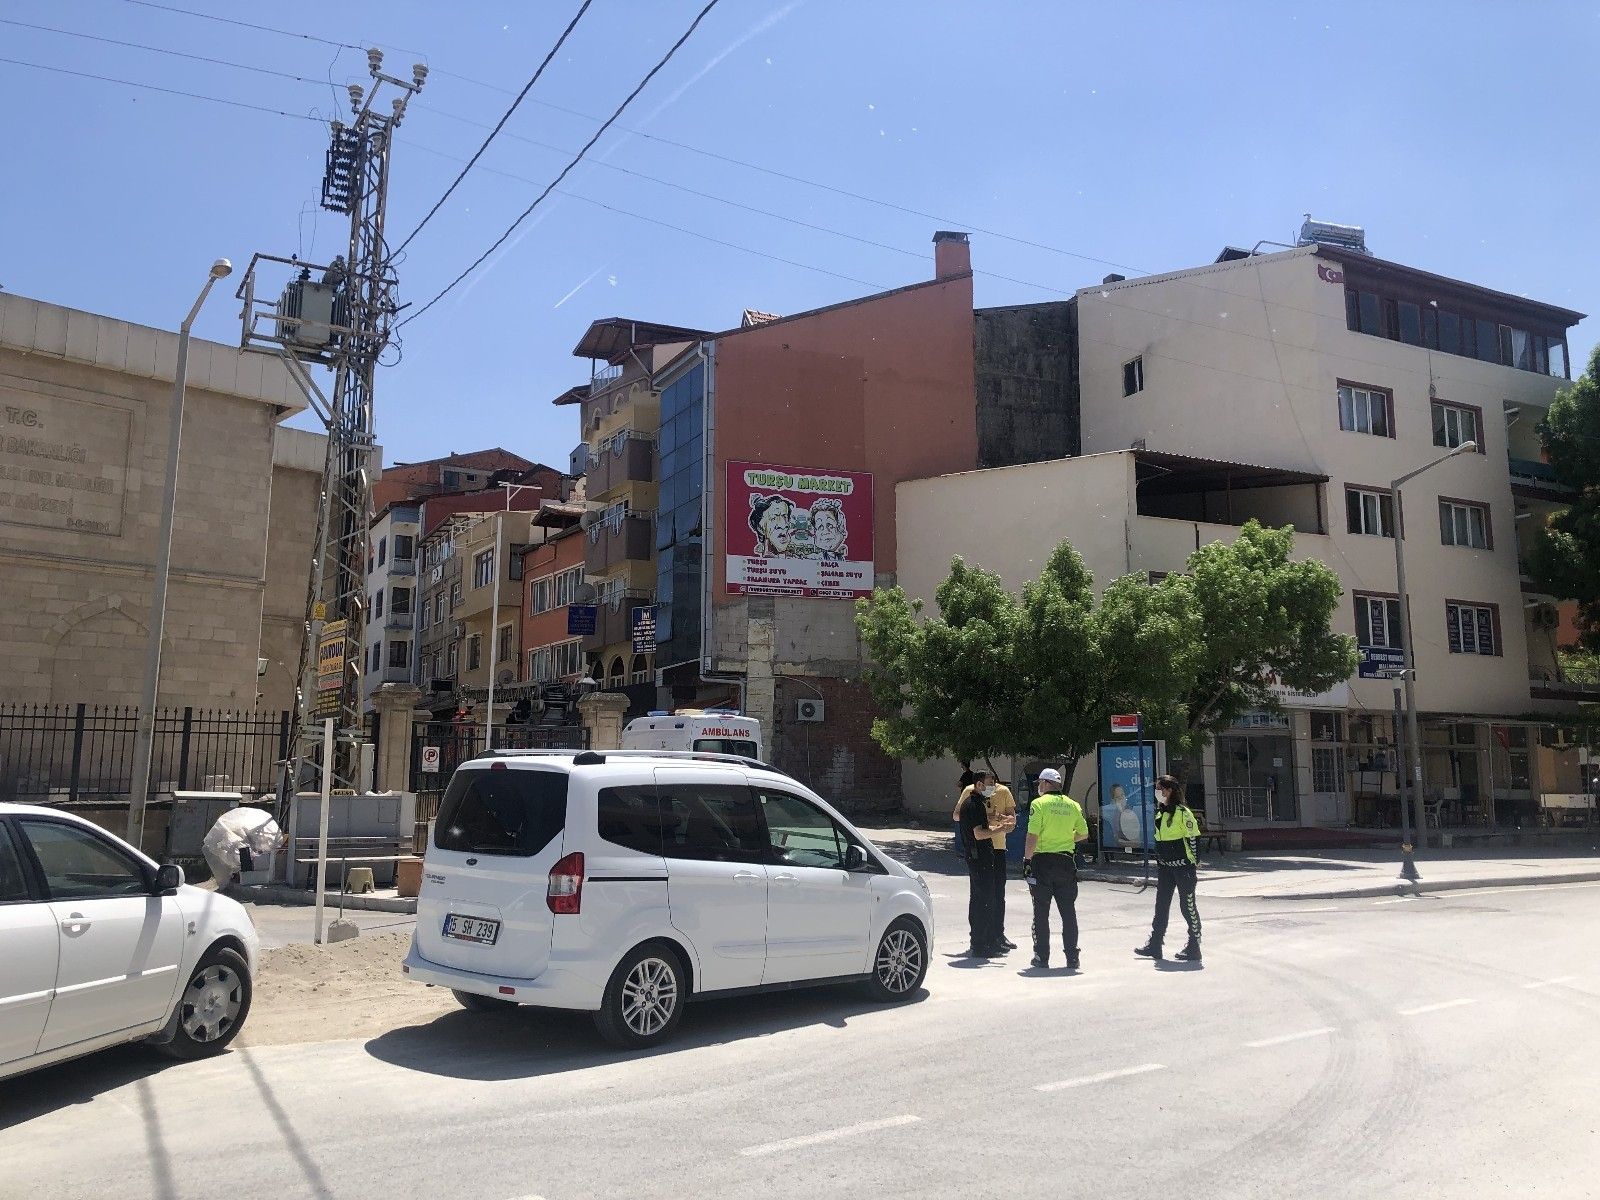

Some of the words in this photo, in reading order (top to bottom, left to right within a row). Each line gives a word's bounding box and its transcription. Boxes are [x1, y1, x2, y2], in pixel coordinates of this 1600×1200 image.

[5, 406, 43, 428] T.C.
[747, 472, 794, 489] TURŞU
[797, 477, 851, 493] MARKET
[701, 727, 750, 738] AMBULANS
[462, 919, 474, 935] SH
[476, 922, 494, 938] 239
